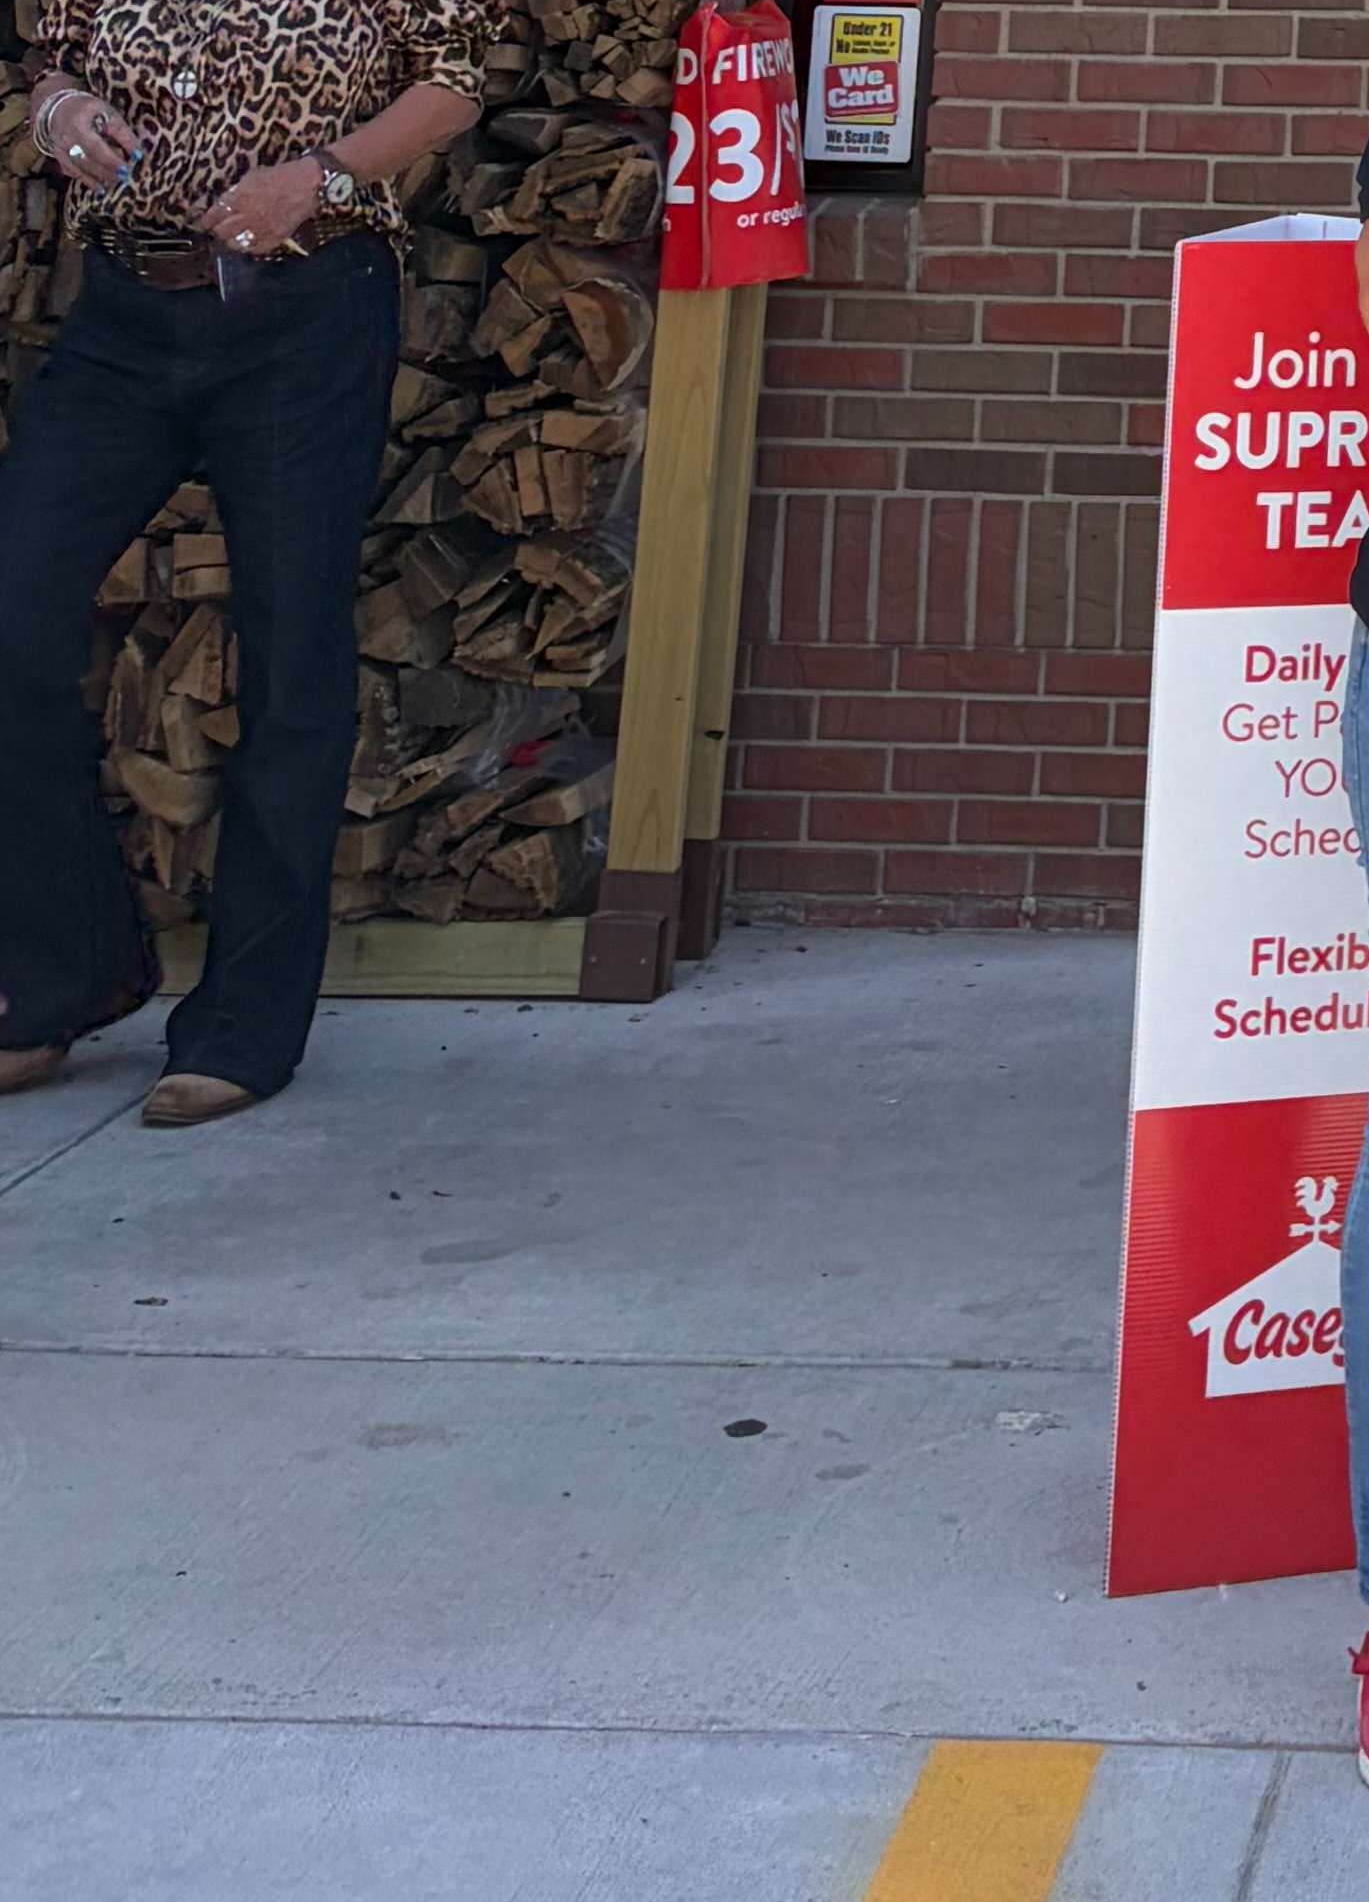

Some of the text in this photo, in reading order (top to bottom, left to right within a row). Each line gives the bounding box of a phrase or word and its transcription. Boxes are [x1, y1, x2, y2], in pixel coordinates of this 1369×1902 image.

[843, 21, 893, 36] Under 21
[838, 66, 884, 87] We
[827, 84, 895, 109] Card
[825, 130, 842, 145] We
[844, 130, 871, 145] Scan
[736, 210, 760, 229] or
[1234, 331, 1356, 390] Join
[1245, 643, 1346, 692] Daily
[1222, 702, 1299, 742] Get
